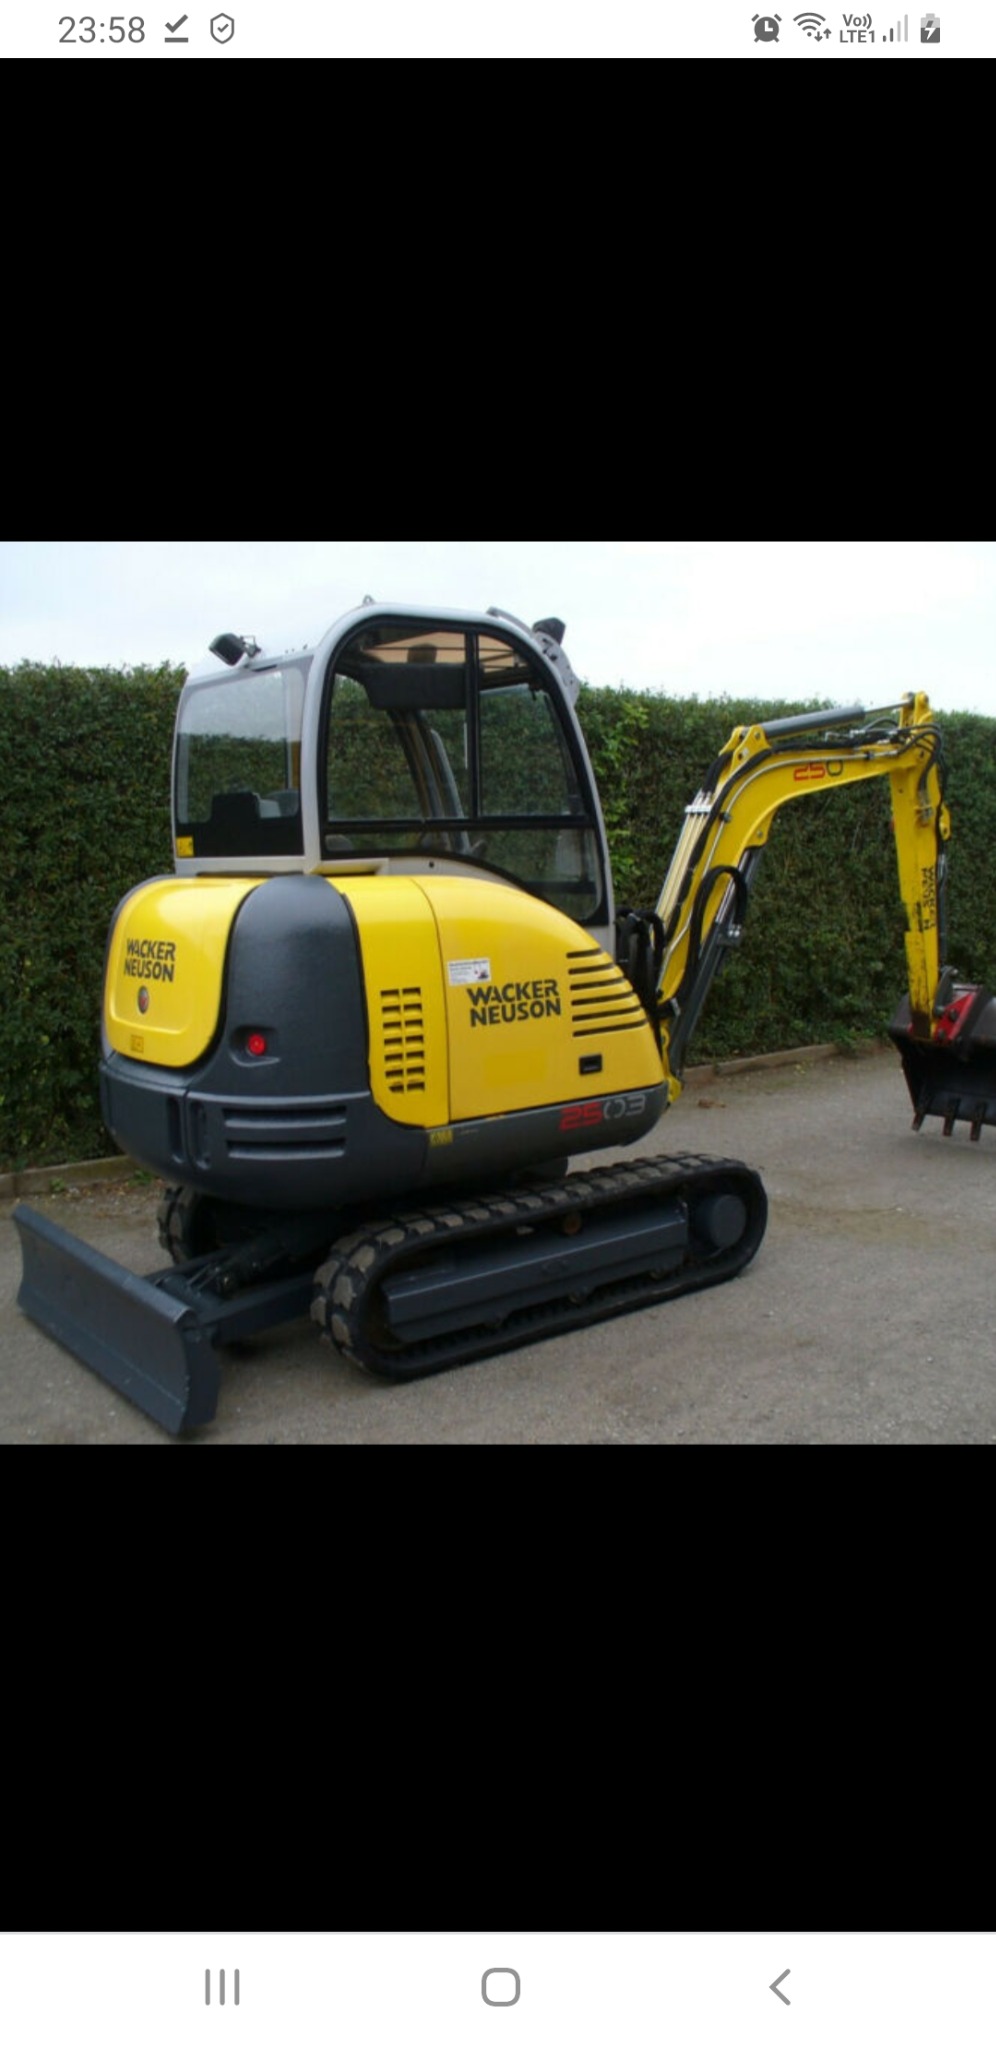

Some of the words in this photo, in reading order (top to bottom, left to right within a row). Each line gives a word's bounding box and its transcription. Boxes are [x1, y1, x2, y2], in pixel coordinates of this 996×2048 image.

[126, 938, 176, 961] WACKER
[124, 958, 175, 982] NEUSON
[467, 979, 560, 1004] WACKER
[470, 999, 561, 1026] NEUSON
[559, 1094, 646, 1131] 2503
